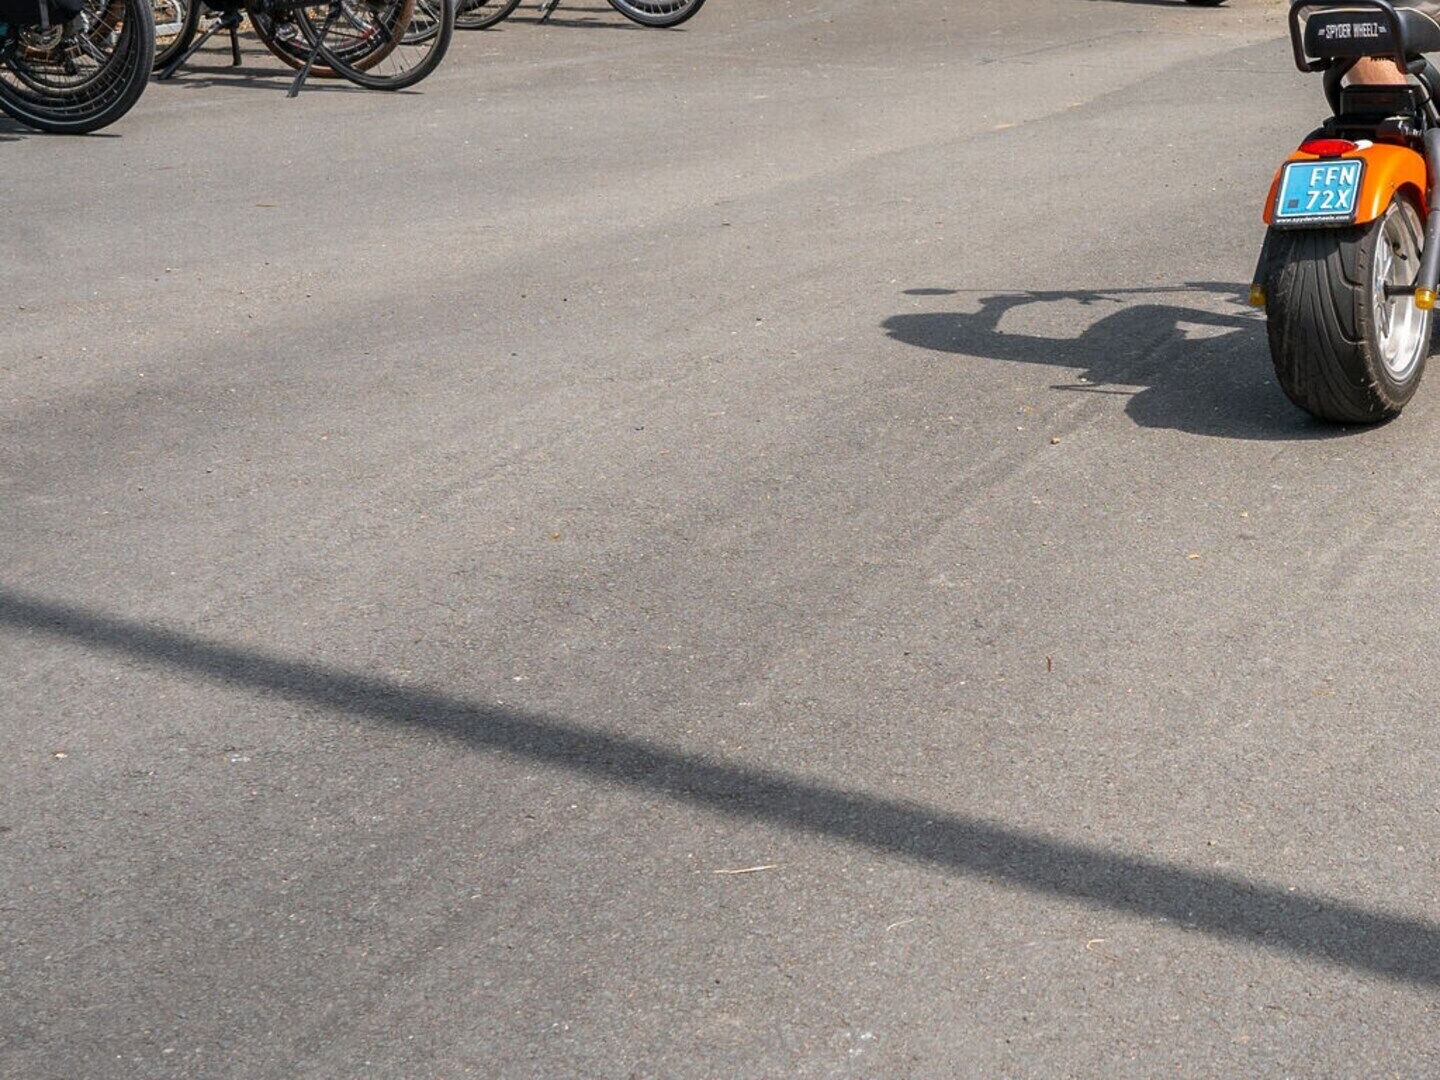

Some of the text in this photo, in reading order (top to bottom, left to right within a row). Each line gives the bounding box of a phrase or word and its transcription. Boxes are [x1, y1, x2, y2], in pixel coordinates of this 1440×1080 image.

[1325, 22, 1379, 39] SPYDER WHEELZ
[1310, 166, 1355, 187] FFN
[1306, 189, 1351, 210] 72X
